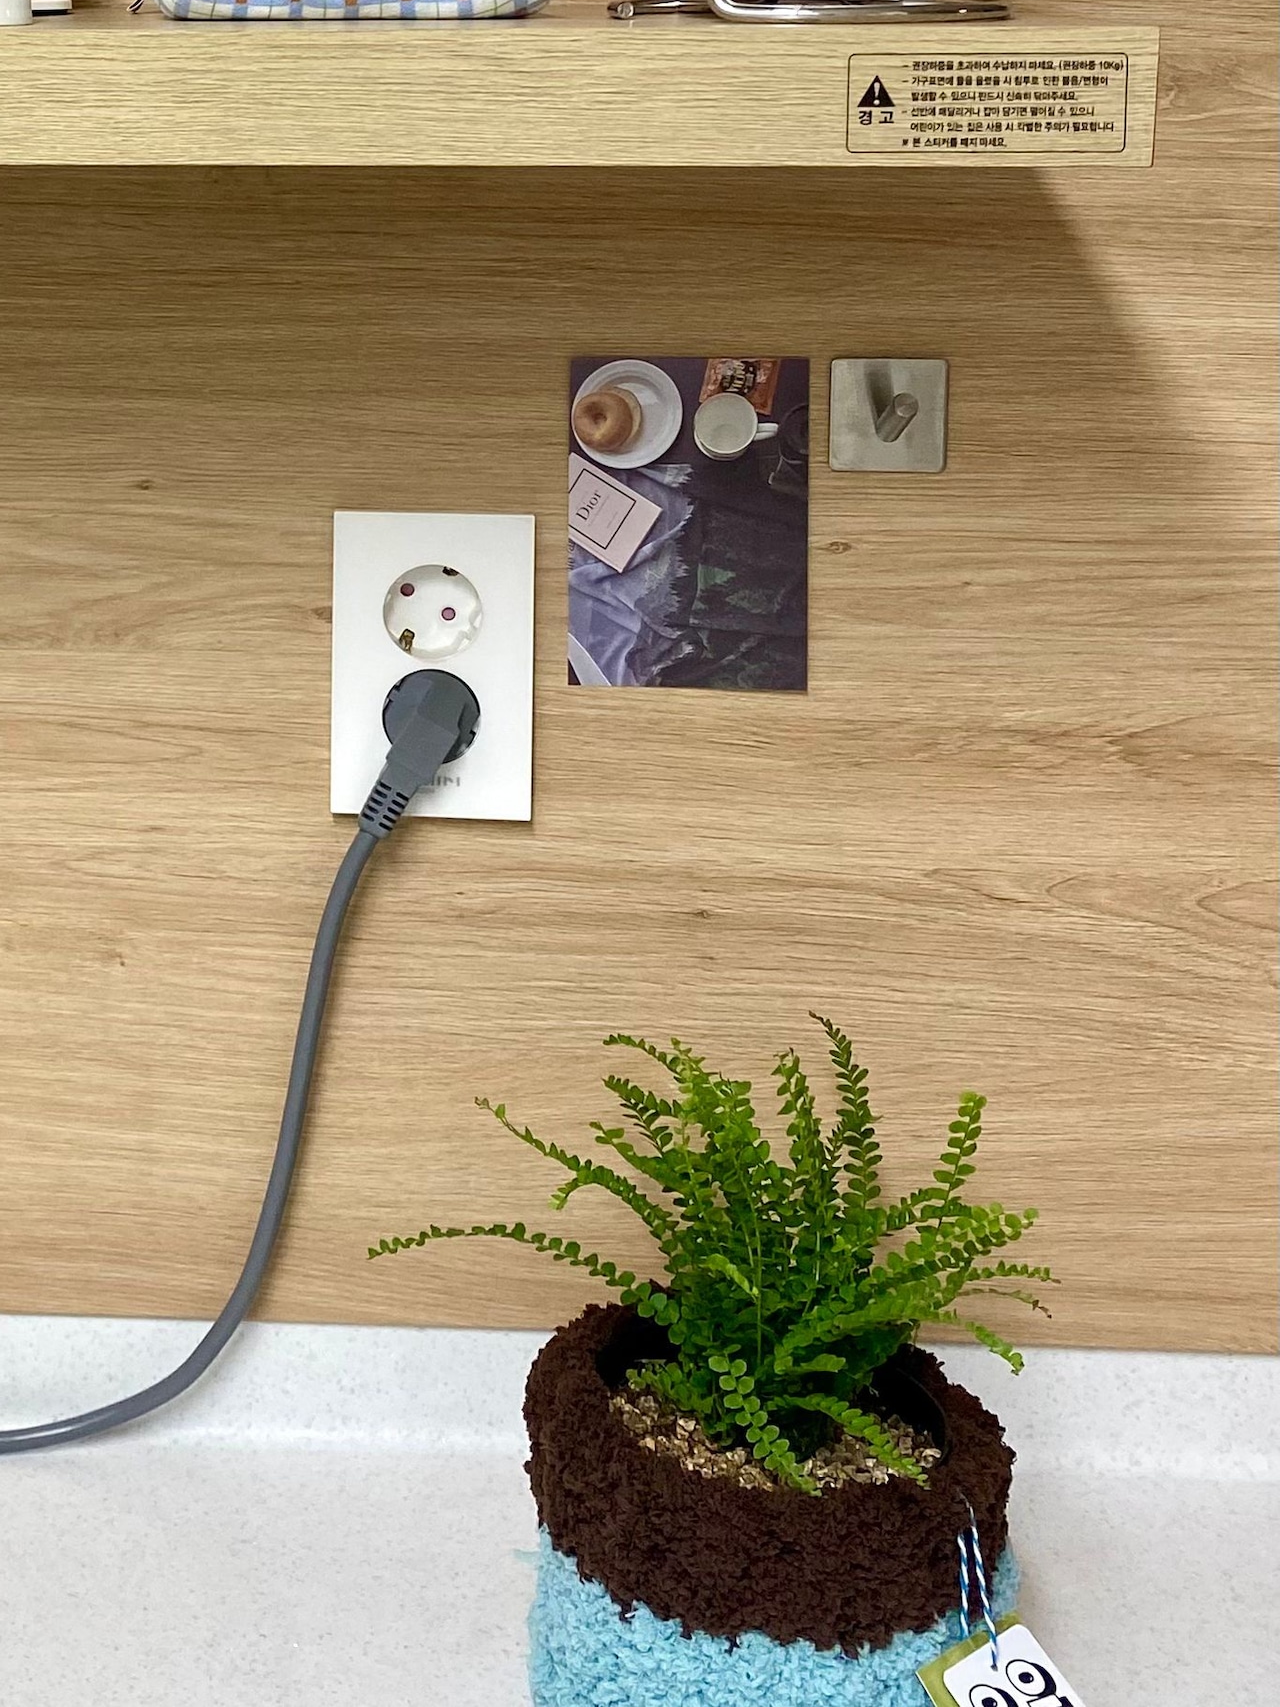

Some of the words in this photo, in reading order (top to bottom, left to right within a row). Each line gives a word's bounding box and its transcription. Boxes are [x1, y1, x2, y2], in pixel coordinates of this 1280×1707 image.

[912, 60, 954, 71] 권장하중을
[955, 60, 991, 71] 초과하여
[911, 75, 954, 86] 가구표면에
[1003, 75, 1012, 86] 시
[938, 91, 948, 101] 수
[950, 91, 976, 101] 있으니
[978, 91, 1004, 101] 반드시
[911, 106, 936, 117] 선반에
[938, 106, 980, 117] 매달리거나
[1057, 106, 1066, 117] 수
[1069, 106, 1095, 116] 있으니
[910, 121, 944, 132] 어린이가
[946, 121, 963, 132] 있는
[985, 121, 1002, 132] 사용
[1005, 121, 1014, 132] 시
[1044, 121, 1070, 132] 주의가
[924, 137, 958, 148] 스티커를
[575, 492, 601, 521] Dior
